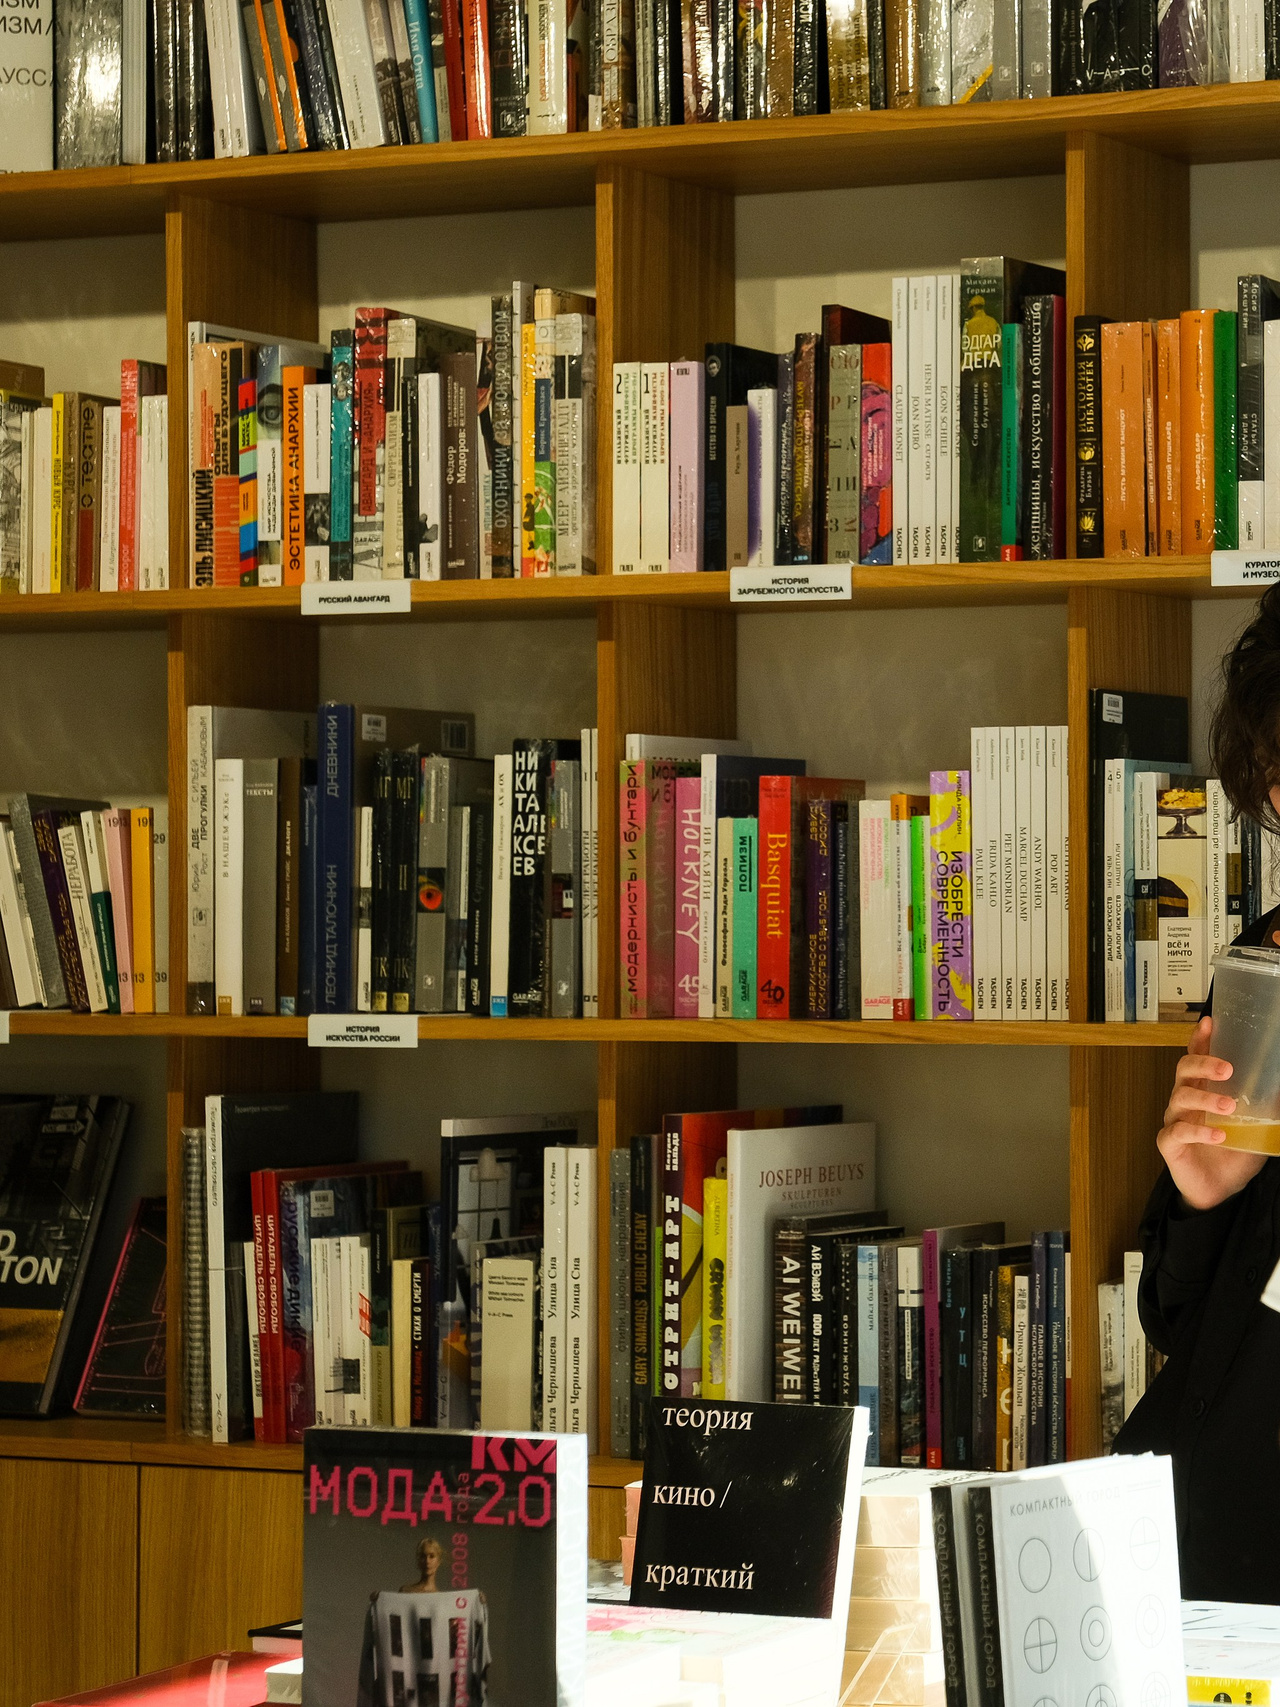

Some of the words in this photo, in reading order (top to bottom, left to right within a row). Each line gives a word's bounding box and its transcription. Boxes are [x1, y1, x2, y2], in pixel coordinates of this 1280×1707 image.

[407, 21, 420, 52] Имя
[412, 55, 425, 89] Отца
[962, 334, 1000, 350] ЭДГАР
[1027, 302, 1042, 375] общество
[962, 351, 1000, 372] ДЕГА
[220, 351, 229, 438] БУДУЩЕГО
[940, 386, 948, 414] EGON
[1030, 380, 1041, 388] и
[1078, 361, 1086, 432] ИСТОРИЯ
[1086, 361, 1094, 432] БИБЛИОТЕК
[289, 387, 299, 469] АНАРХИИ
[1029, 394, 1042, 468] искусство
[388, 415, 397, 487] СЮРРЕАЛИЗМ
[447, 446, 457, 484] Фёдор
[457, 429, 467, 483] Модоров:
[557, 402, 568, 494] АЙЗЕНШТАДТ
[193, 470, 213, 552] ЛИСИЦКИЙ
[289, 476, 300, 570] ЭСТЕТИКА
[558, 500, 569, 536] МЕЕР
[196, 557, 213, 586] ЭЛЬ
[737, 587, 794, 596] ЗАРУБЕЖНОГО
[796, 586, 844, 594] ИСКУССТВА
[771, 577, 809, 586] ИСТОРИЯ
[318, 595, 352, 604] РУССКИЙ
[353, 595, 390, 604] АВАНГАРД
[326, 715, 339, 797] ДНЕВНИКИ
[516, 751, 538, 771] НИ
[516, 772, 537, 792] КИ
[515, 794, 540, 812] ТА
[623, 765, 641, 842] бунтари
[1211, 792, 1220, 835] marginem
[154, 834, 166, 844] 29
[474, 814, 484, 864] тетради
[513, 834, 546, 854] КСЕ
[626, 848, 637, 859] и
[703, 826, 712, 845] ИВ
[989, 840, 997, 869] FRIDA
[1004, 833, 1012, 854] PIET
[1034, 836, 1042, 864] ANDY
[1211, 838, 1219, 849] ad
[61, 833, 84, 899] НЕРАБОТА
[513, 856, 536, 876] ЕВ
[677, 809, 700, 943] HOCKNEY
[702, 851, 713, 900] КЛЯЙН
[739, 836, 748, 892] ПОПИЗМ
[1211, 853, 1221, 912] экологичным
[325, 865, 338, 941] ТАЛОЧКИН
[474, 868, 483, 902] Серые
[761, 832, 787, 939] Basquiat
[951, 851, 963, 958] ИЗОБРЕСТИ
[976, 876, 984, 899] KLEE
[989, 873, 997, 907] KAHLO
[1004, 857, 1012, 913] MONDRIAN
[625, 868, 640, 992] модернисты
[721, 918, 729, 966] Философия
[937, 851, 950, 1011] СОВРЕМЕННОСТЬ
[1212, 915, 1220, 938] стать
[155, 972, 167, 983] 39
[326, 944, 338, 1005] ЛЕОНИД
[678, 974, 700, 996] 45
[739, 970, 748, 1001] GARAGE
[760, 979, 784, 1001] 40
[326, 1034, 368, 1043] ИСКУССТВА
[370, 1034, 400, 1043] РОССИИ
[346, 1025, 380, 1034] ИСТОРИЯ
[759, 1168, 812, 1188] JOSEPH
[818, 1163, 864, 1184] BEUYS
[254, 1215, 264, 1274] ЦИТАДЕЛЬ
[267, 1215, 277, 1274] ЦИТАДЕЛЬ
[635, 1212, 647, 1250] ENEMY
[783, 1256, 800, 1284] AI
[811, 1245, 823, 1260] АЙ
[635, 1253, 647, 1292] PUBLIC
[811, 1263, 824, 1302] ВЭЙВЭЙ
[256, 1277, 267, 1333] СВОБОДЫ
[270, 1277, 279, 1333] СВОБОДЫ
[664, 1195, 680, 1390] СТРИТ-АРТ
[634, 1299, 647, 1353] SIMMONS
[812, 1314, 822, 1335] 1000
[1016, 1321, 1025, 1363] Франсуа
[783, 1292, 801, 1399] WEIWEI
[812, 1337, 820, 1352] ЛЕТ
[635, 1357, 647, 1385] GARY
[1017, 1366, 1026, 1407] Жюльен
[662, 1406, 754, 1436] теория
[309, 1464, 453, 1527] МОДА
[473, 1472, 552, 1528] 2.0
[456, 1472, 470, 1524] года
[652, 1484, 716, 1508] кино
[718, 1480, 732, 1508] /
[452, 1532, 469, 1588] 2008
[645, 1562, 755, 1591] краткий
[975, 1513, 993, 1628] КОМПАКТНЫЙ
[935, 1513, 954, 1626] КОМПАКТНЫЙ
[945, 1634, 958, 1688] ГОРОД
[983, 1636, 995, 1689] ГОРОД
